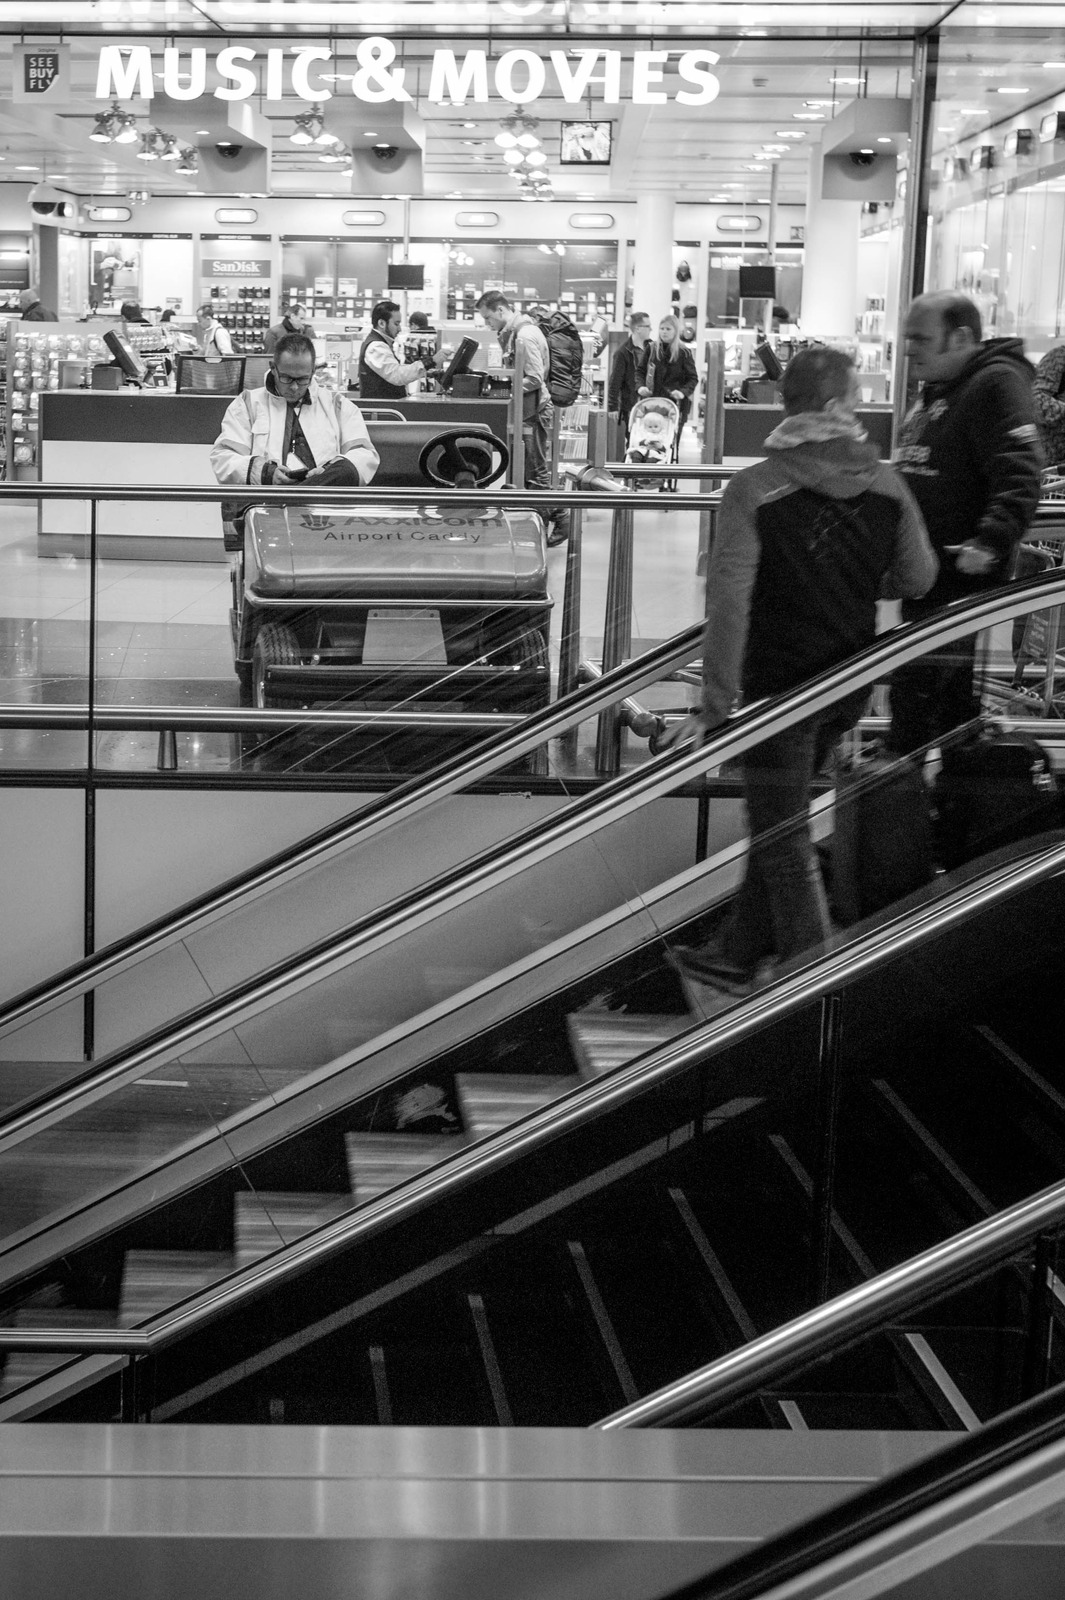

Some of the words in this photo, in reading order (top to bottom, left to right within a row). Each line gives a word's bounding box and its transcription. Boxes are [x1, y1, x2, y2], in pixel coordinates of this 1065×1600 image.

[29, 57, 54, 67] SEE
[29, 68, 54, 78] BUY
[95, 46, 333, 102] MUSIC
[352, 36, 414, 103] &
[428, 49, 721, 106] MOVIES
[212, 260, 263, 272] SanDisk
[324, 531, 401, 542] Airport
[410, 531, 481, 543] Caddy
